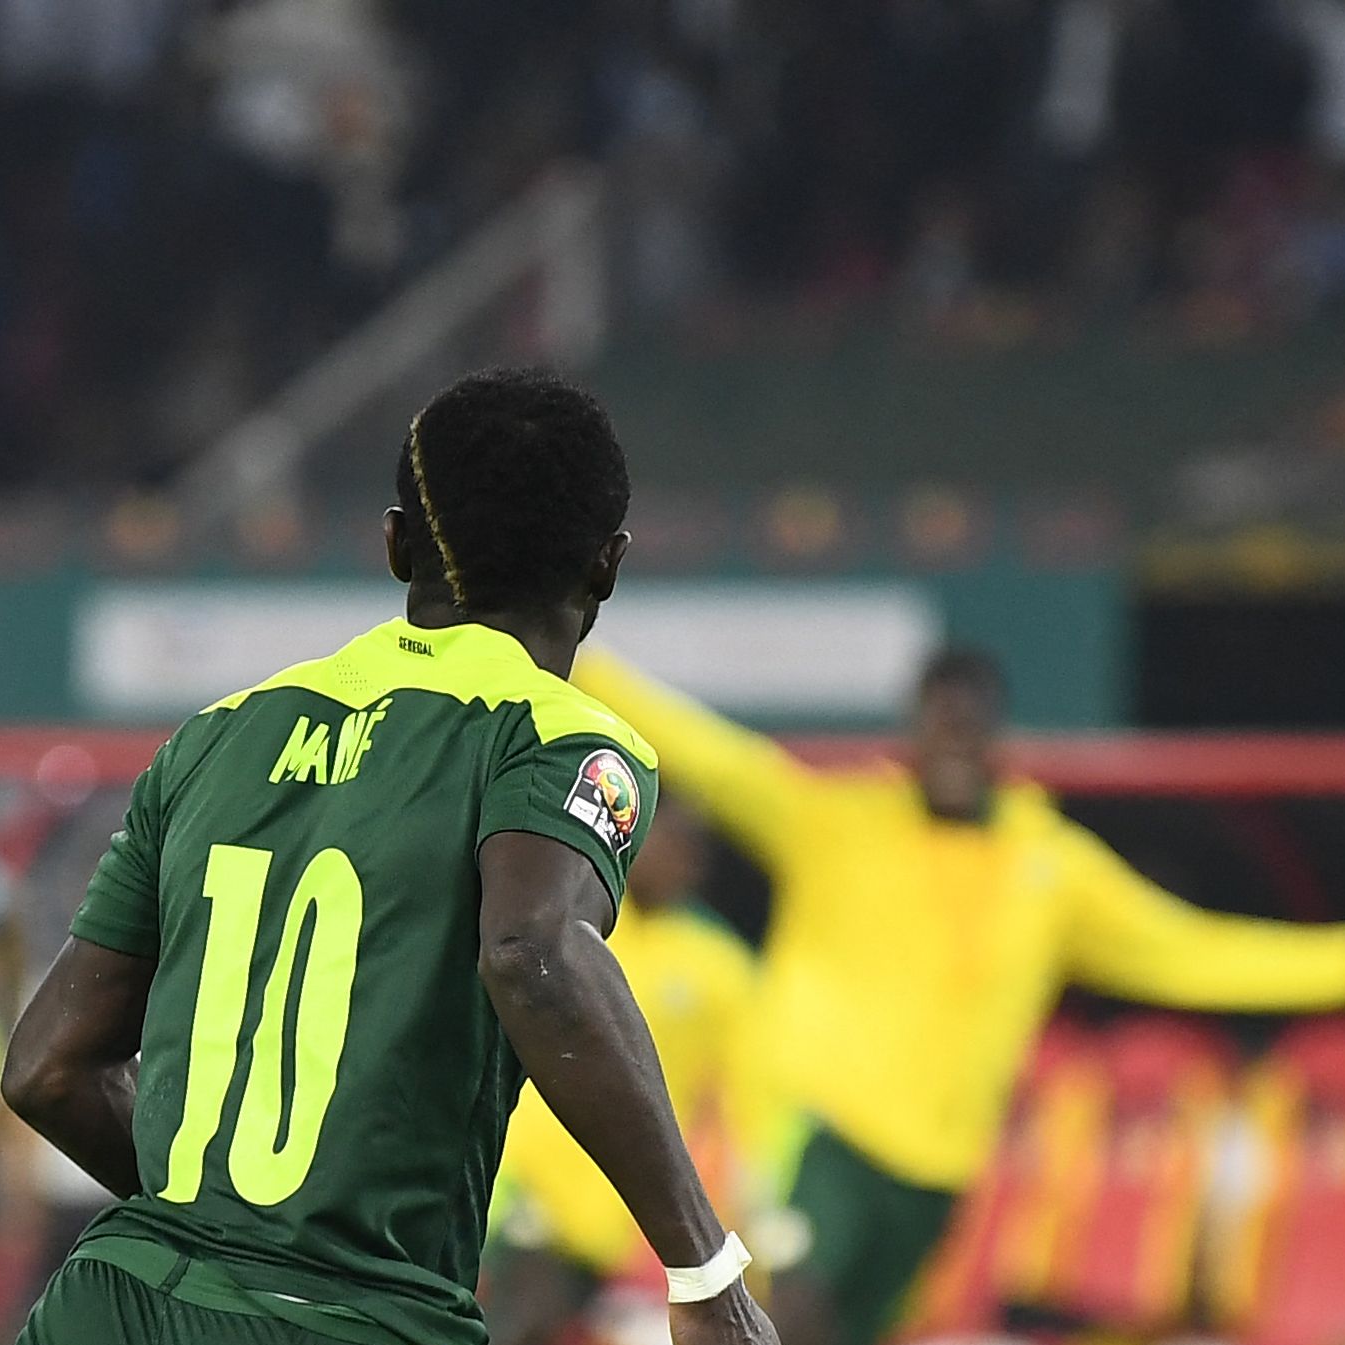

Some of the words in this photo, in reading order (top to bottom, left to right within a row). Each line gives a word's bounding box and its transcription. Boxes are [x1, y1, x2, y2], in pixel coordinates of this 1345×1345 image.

[398, 635, 435, 657] SENEGAL
[268, 697, 393, 785] MANÉ
[156, 843, 363, 1206] 10
